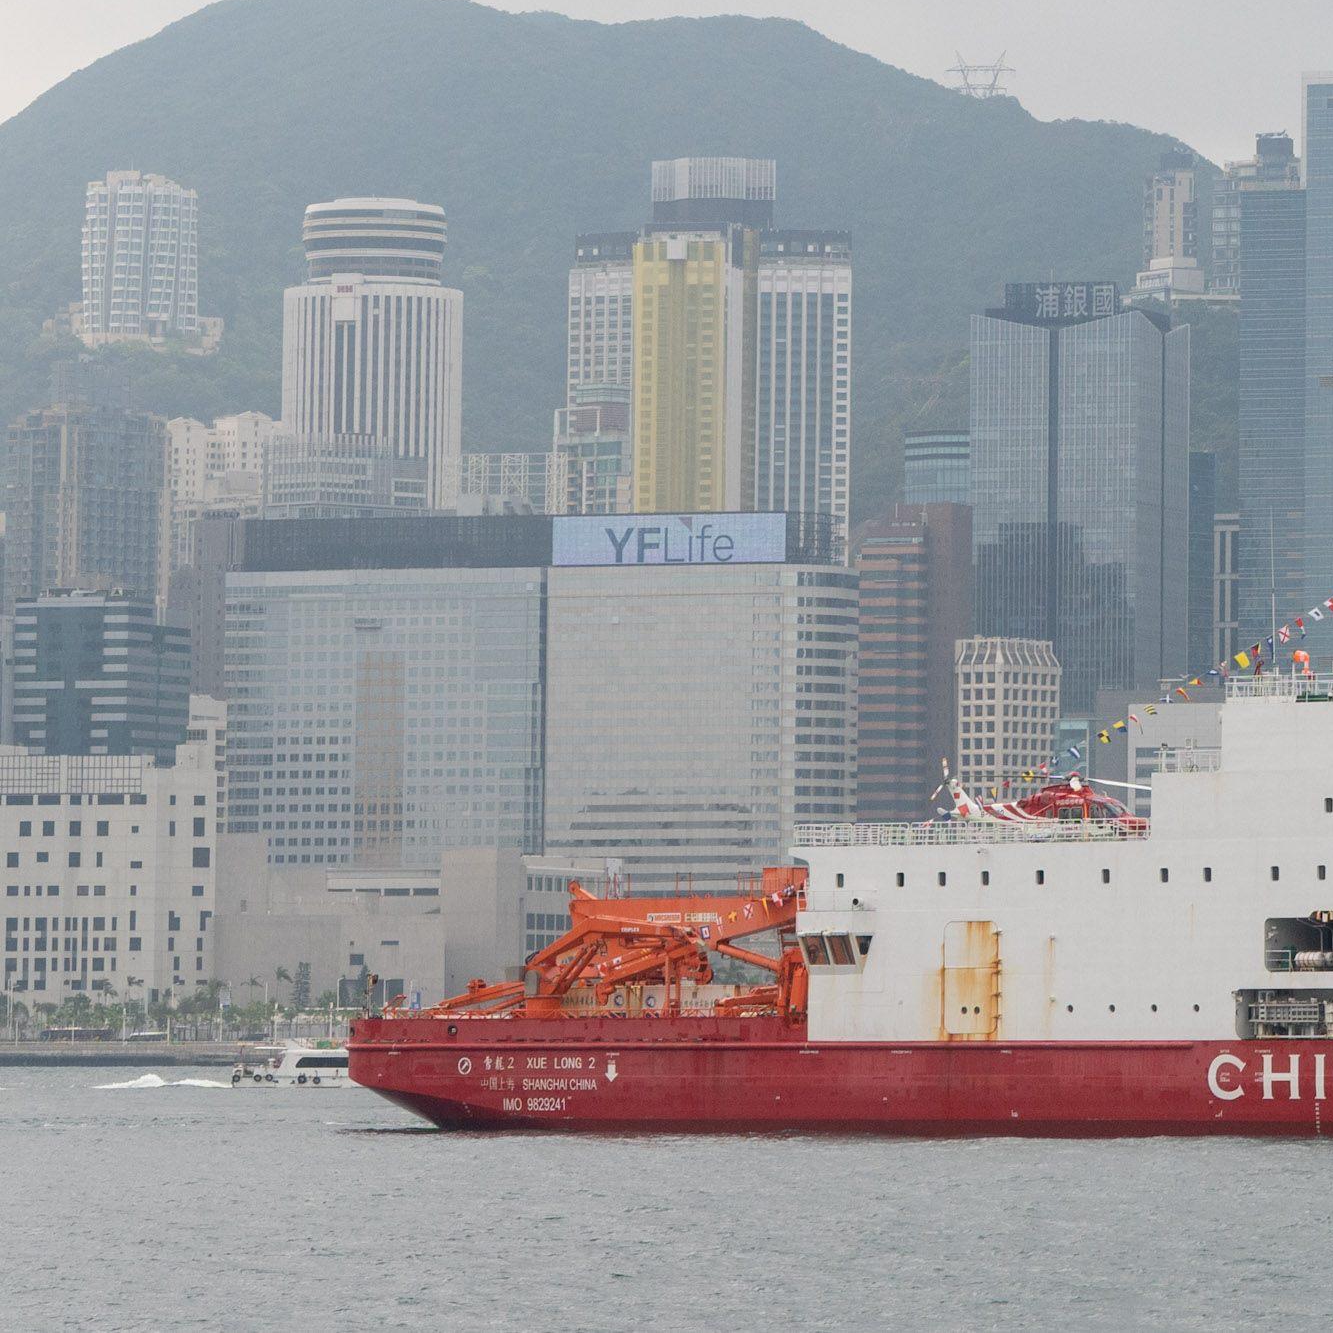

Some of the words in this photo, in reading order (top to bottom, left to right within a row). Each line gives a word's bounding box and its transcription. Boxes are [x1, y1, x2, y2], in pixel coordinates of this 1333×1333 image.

[526, 1057, 547, 1069] XUE
[554, 1057, 582, 1069] LONG
[588, 1057, 596, 1069] 2
[522, 1078, 567, 1091] SHANGHAI
[569, 1078, 597, 1091] CHINA
[503, 1097, 522, 1111] IMO
[527, 1097, 566, 1111] 9829241
